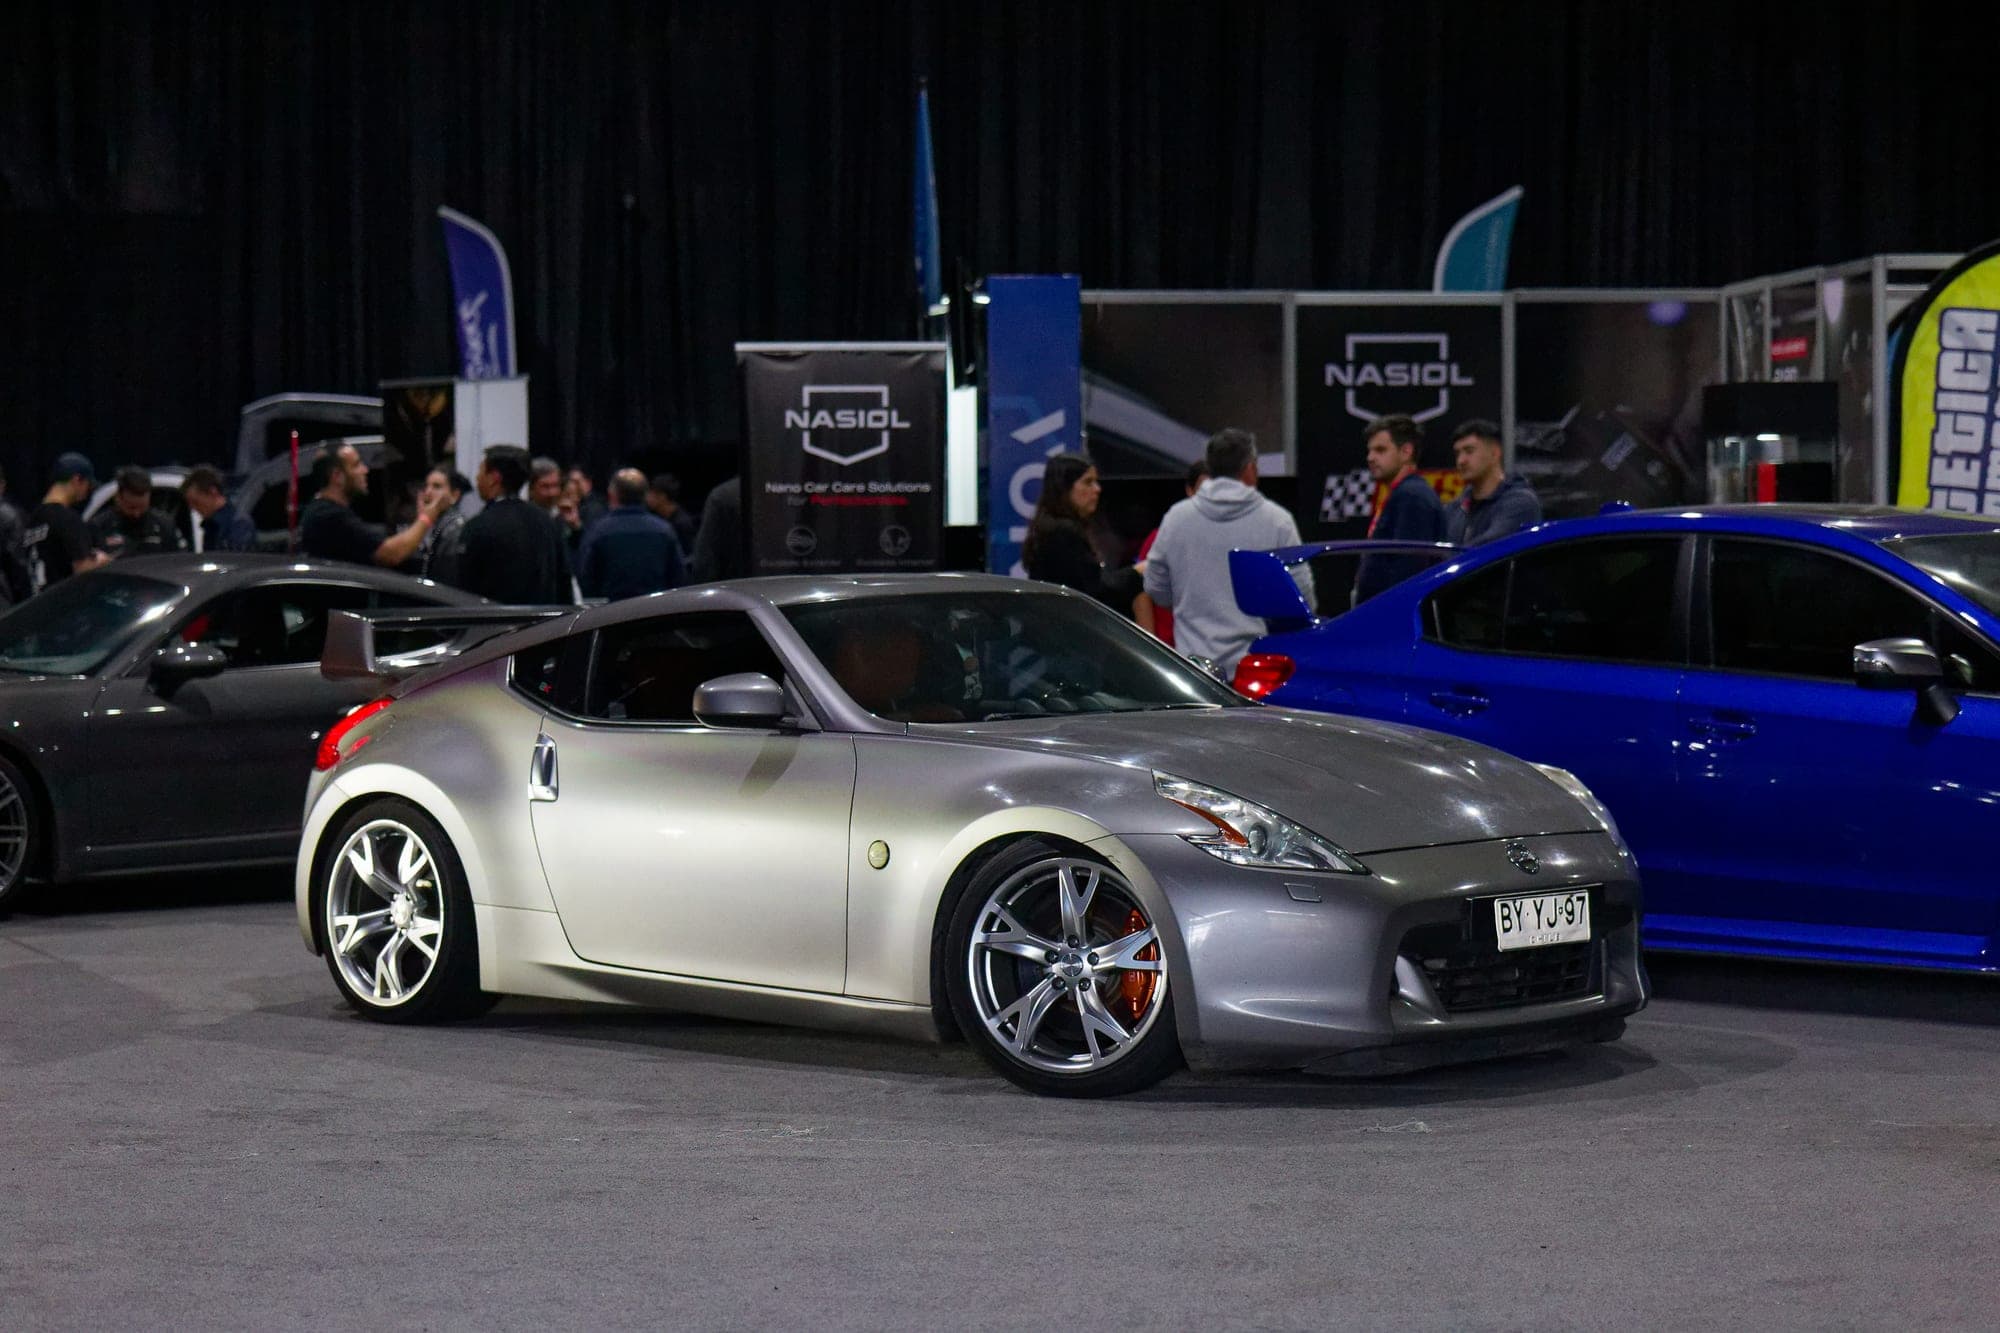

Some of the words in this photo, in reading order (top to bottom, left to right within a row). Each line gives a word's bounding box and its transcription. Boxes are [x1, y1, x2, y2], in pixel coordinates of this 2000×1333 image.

[1324, 362, 1475, 387] NASIOL
[784, 409, 911, 429] NASIOL
[765, 481, 802, 493] Nano
[804, 481, 829, 493] Car
[831, 481, 866, 493] Care
[867, 481, 932, 493] Solutions
